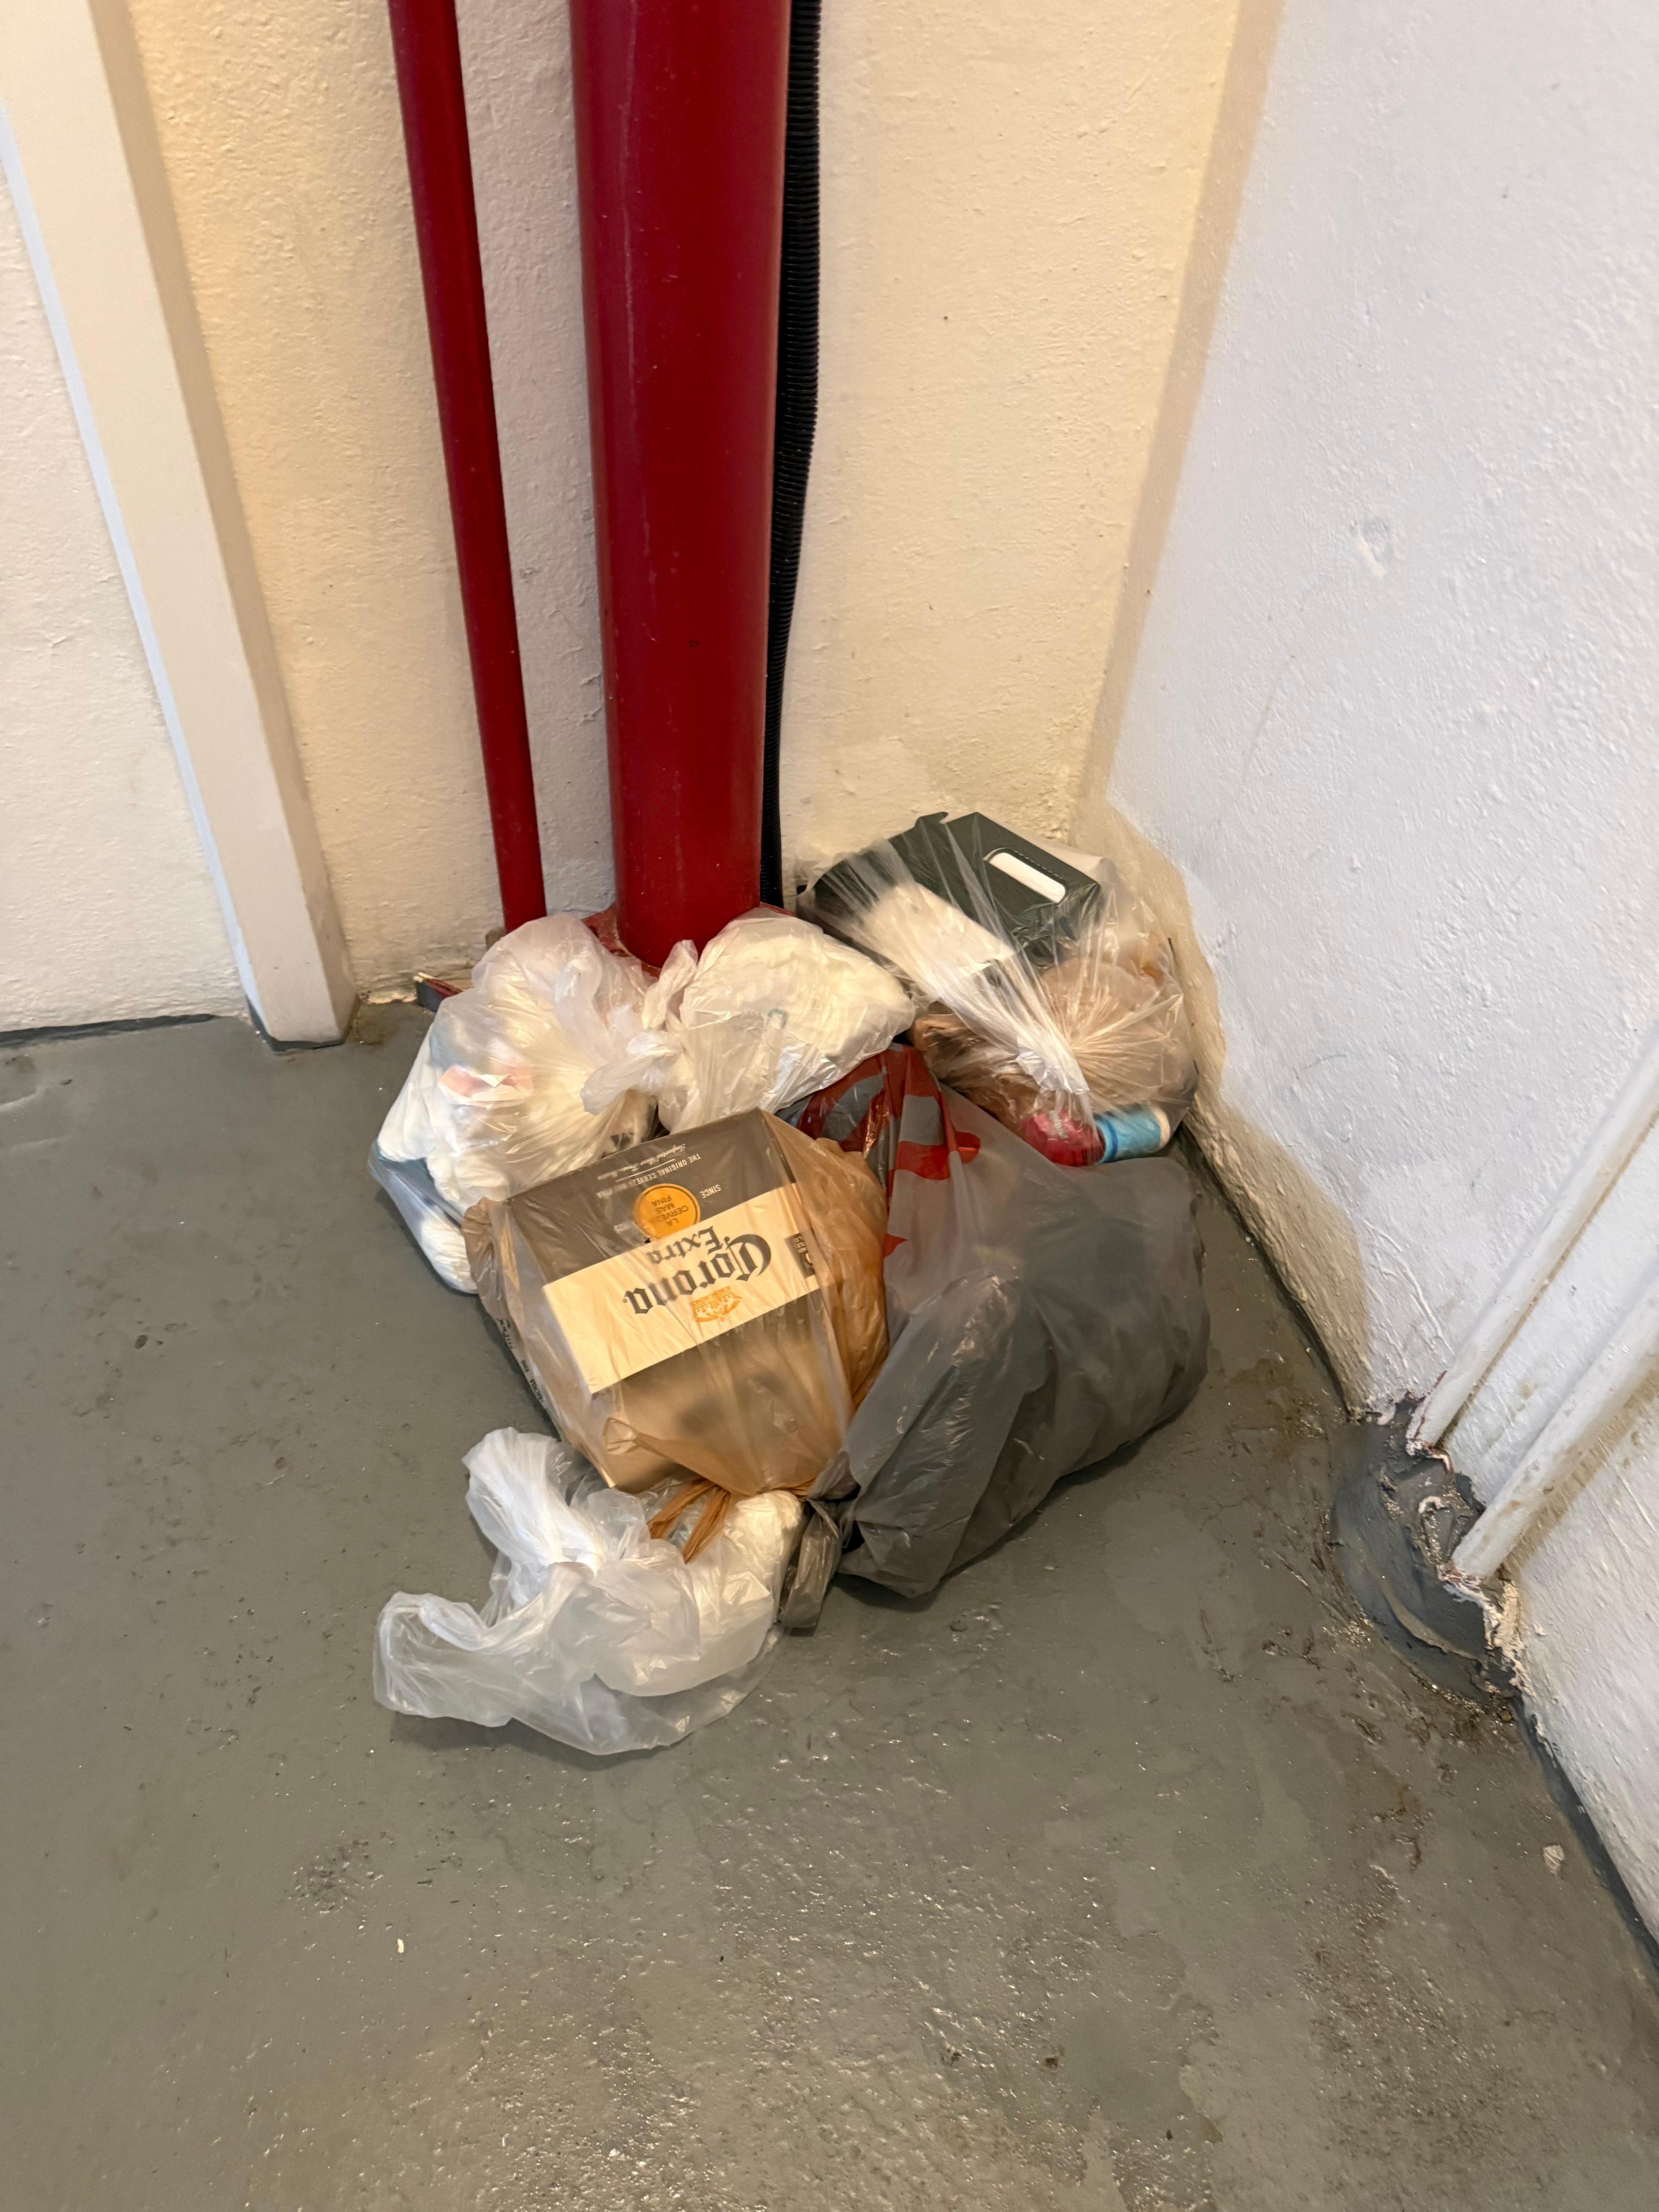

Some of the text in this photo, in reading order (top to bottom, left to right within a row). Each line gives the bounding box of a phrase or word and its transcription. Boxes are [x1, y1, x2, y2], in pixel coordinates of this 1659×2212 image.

[687, 1153, 702, 1164] THE
[657, 1160, 688, 1177] ORIGINAL
[629, 1172, 657, 1185] CERVEZ
[699, 1184, 721, 1199] SINCE
[651, 1194, 672, 1207] FINA
[654, 1205, 689, 1221] CERVE
[648, 1226, 723, 1264] Extra
[626, 1234, 771, 1314] Corona
